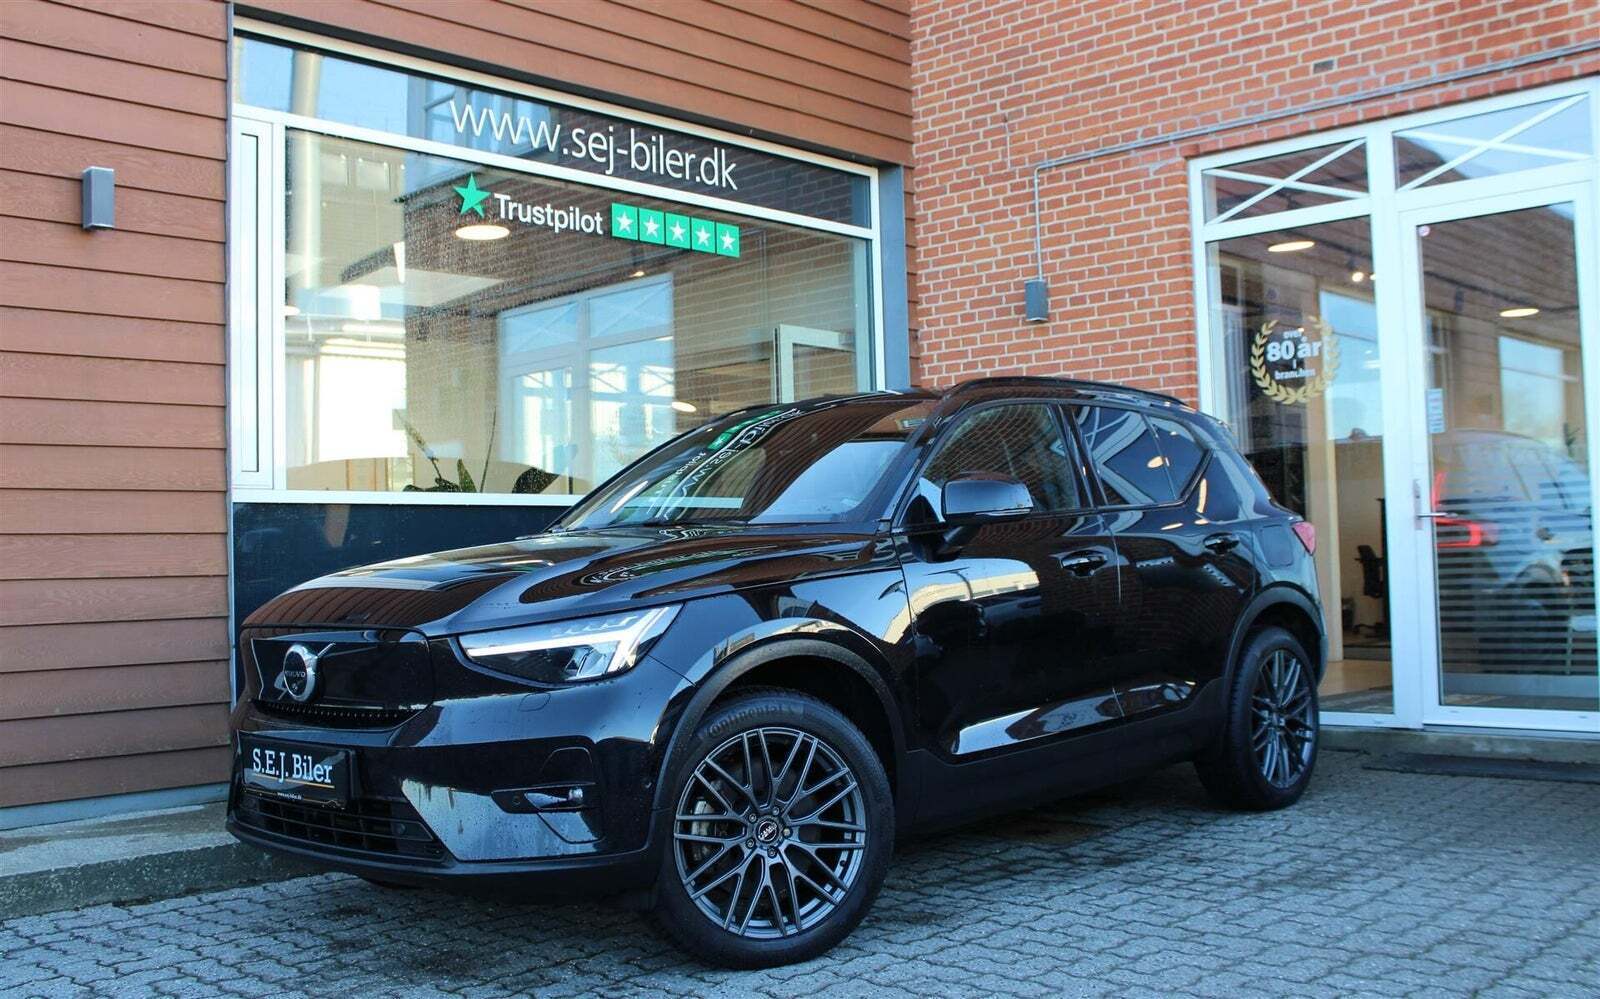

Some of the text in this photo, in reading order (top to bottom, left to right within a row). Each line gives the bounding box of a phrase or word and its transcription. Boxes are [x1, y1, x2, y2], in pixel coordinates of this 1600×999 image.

[449, 100, 738, 191] www.sej-biler.dk
[494, 192, 604, 236] Trustpilot
[1266, 336, 1322, 362] 80 år
[252, 747, 333, 784] S.E.J. Biler
